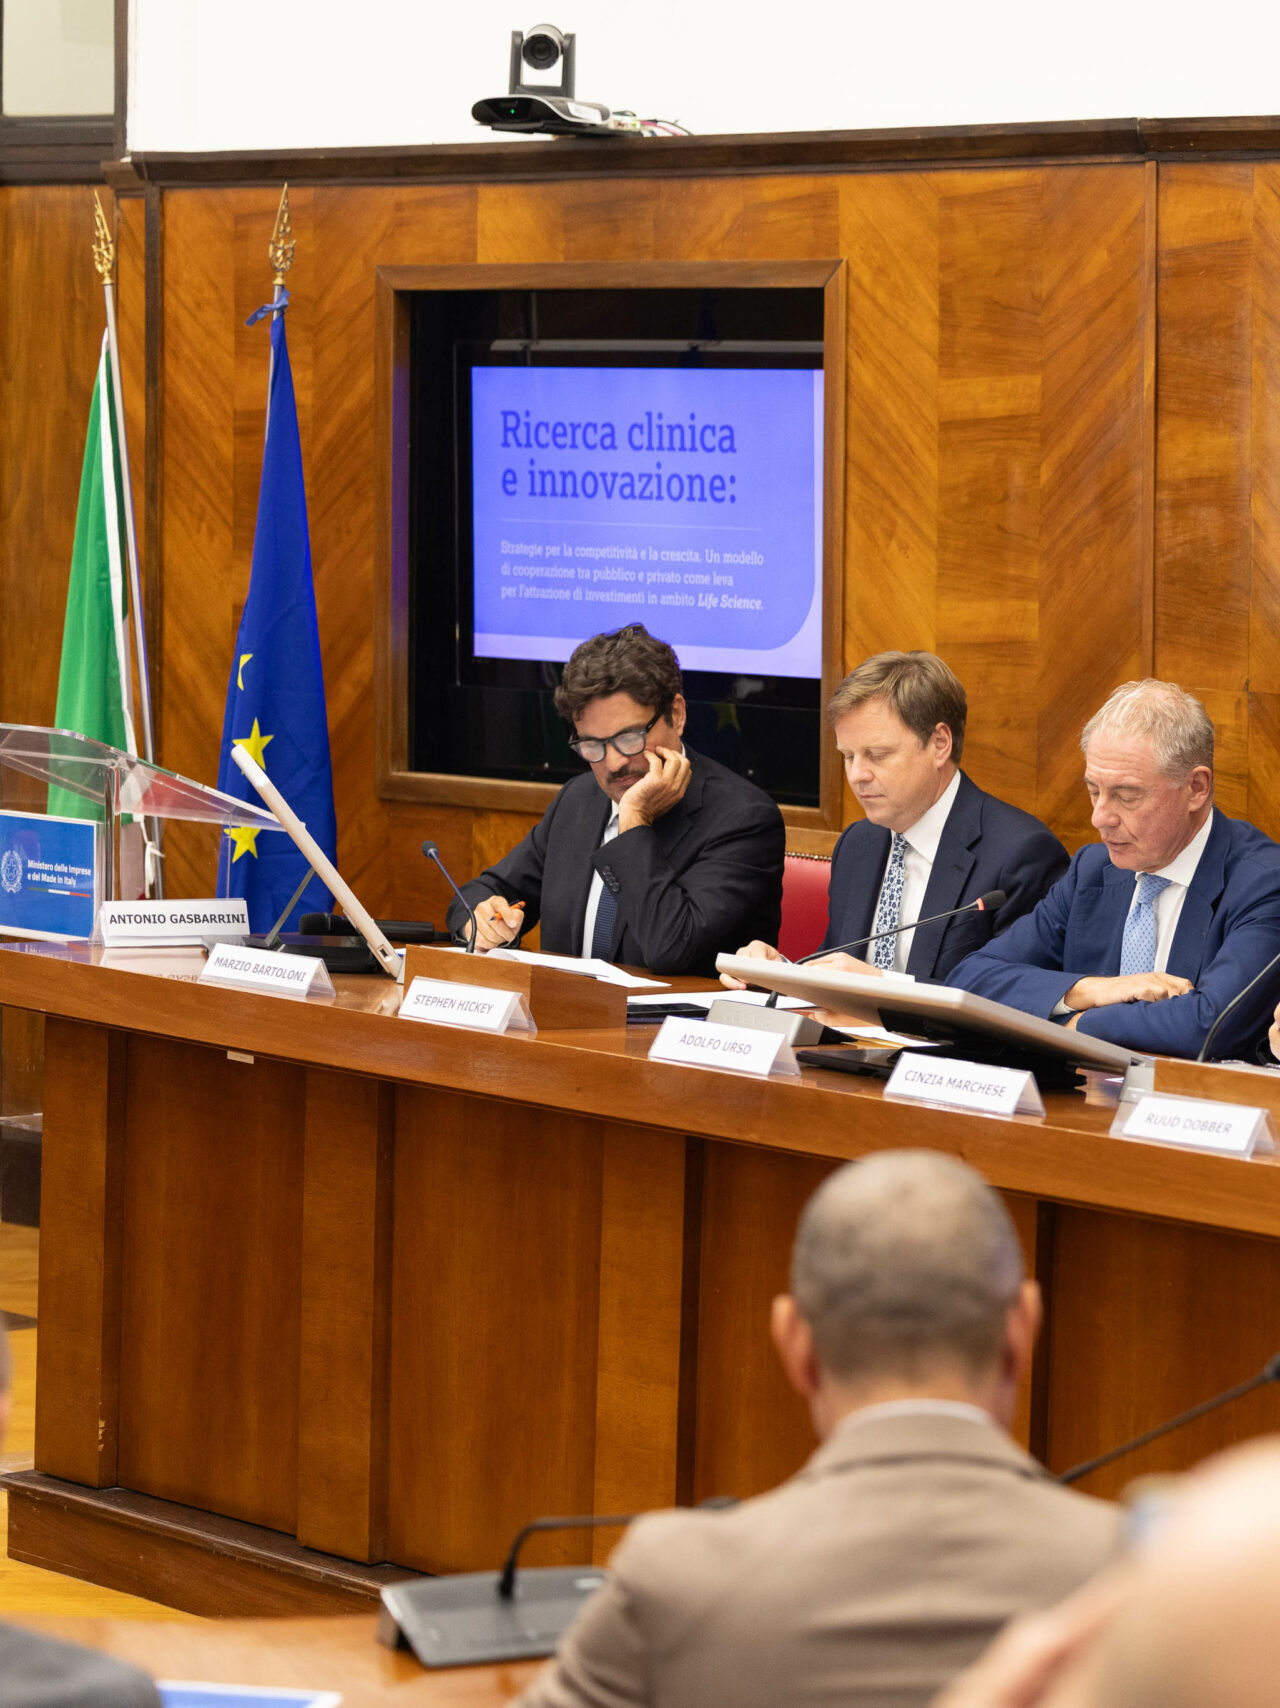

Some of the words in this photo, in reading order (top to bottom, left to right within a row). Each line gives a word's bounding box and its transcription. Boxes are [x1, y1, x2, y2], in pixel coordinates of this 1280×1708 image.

[501, 410, 618, 450] Ricerca
[627, 411, 737, 453] clinica
[501, 466, 518, 497] e
[528, 459, 737, 504] innovazione:
[501, 540, 543, 558] Strategie
[545, 545, 560, 558] per
[563, 543, 573, 557] la
[574, 545, 638, 560] competitività
[640, 549, 646, 560] e
[649, 546, 658, 561] la
[660, 548, 702, 562] crescita.
[705, 549, 720, 563] Un
[723, 550, 764, 566] modello
[501, 562, 511, 576] di
[512, 564, 575, 579] cooperazione
[577, 567, 590, 580] tra
[593, 566, 635, 582] pubblico
[638, 571, 644, 582] e
[646, 569, 681, 584] privato
[683, 574, 710, 585] come
[712, 571, 734, 586] leva
[501, 586, 516, 599] per
[519, 584, 571, 600] l'attrazione
[573, 587, 583, 600] di
[585, 588, 645, 604] investimenti
[647, 591, 657, 604] in
[660, 592, 695, 606] ambito
[697, 593, 718, 611] Life
[720, 594, 764, 610] Science.
[28, 859, 53, 871] Ministero
[54, 863, 68, 872] delle
[69, 865, 91, 876] Imprese
[32, 872, 40, 881] del
[41, 873, 56, 883] Made
[57, 875, 63, 884] in
[64, 876, 76, 888] Italy
[109, 914, 166, 925] ANTONIO
[169, 913, 246, 925] GASBARRINI
[214, 957, 251, 972] MARZIO
[251, 963, 308, 983] BARTOLONI
[413, 994, 457, 1010] STEPHEN
[457, 999, 494, 1016] HICKEY
[678, 1033, 722, 1052] ADOLFO
[723, 1040, 753, 1056] URSO
[904, 1070, 944, 1087] CINZIA
[945, 1076, 1007, 1098] MARCHESE
[1145, 1112, 1183, 1130] RUUD
[1184, 1117, 1233, 1135] DOBBER
